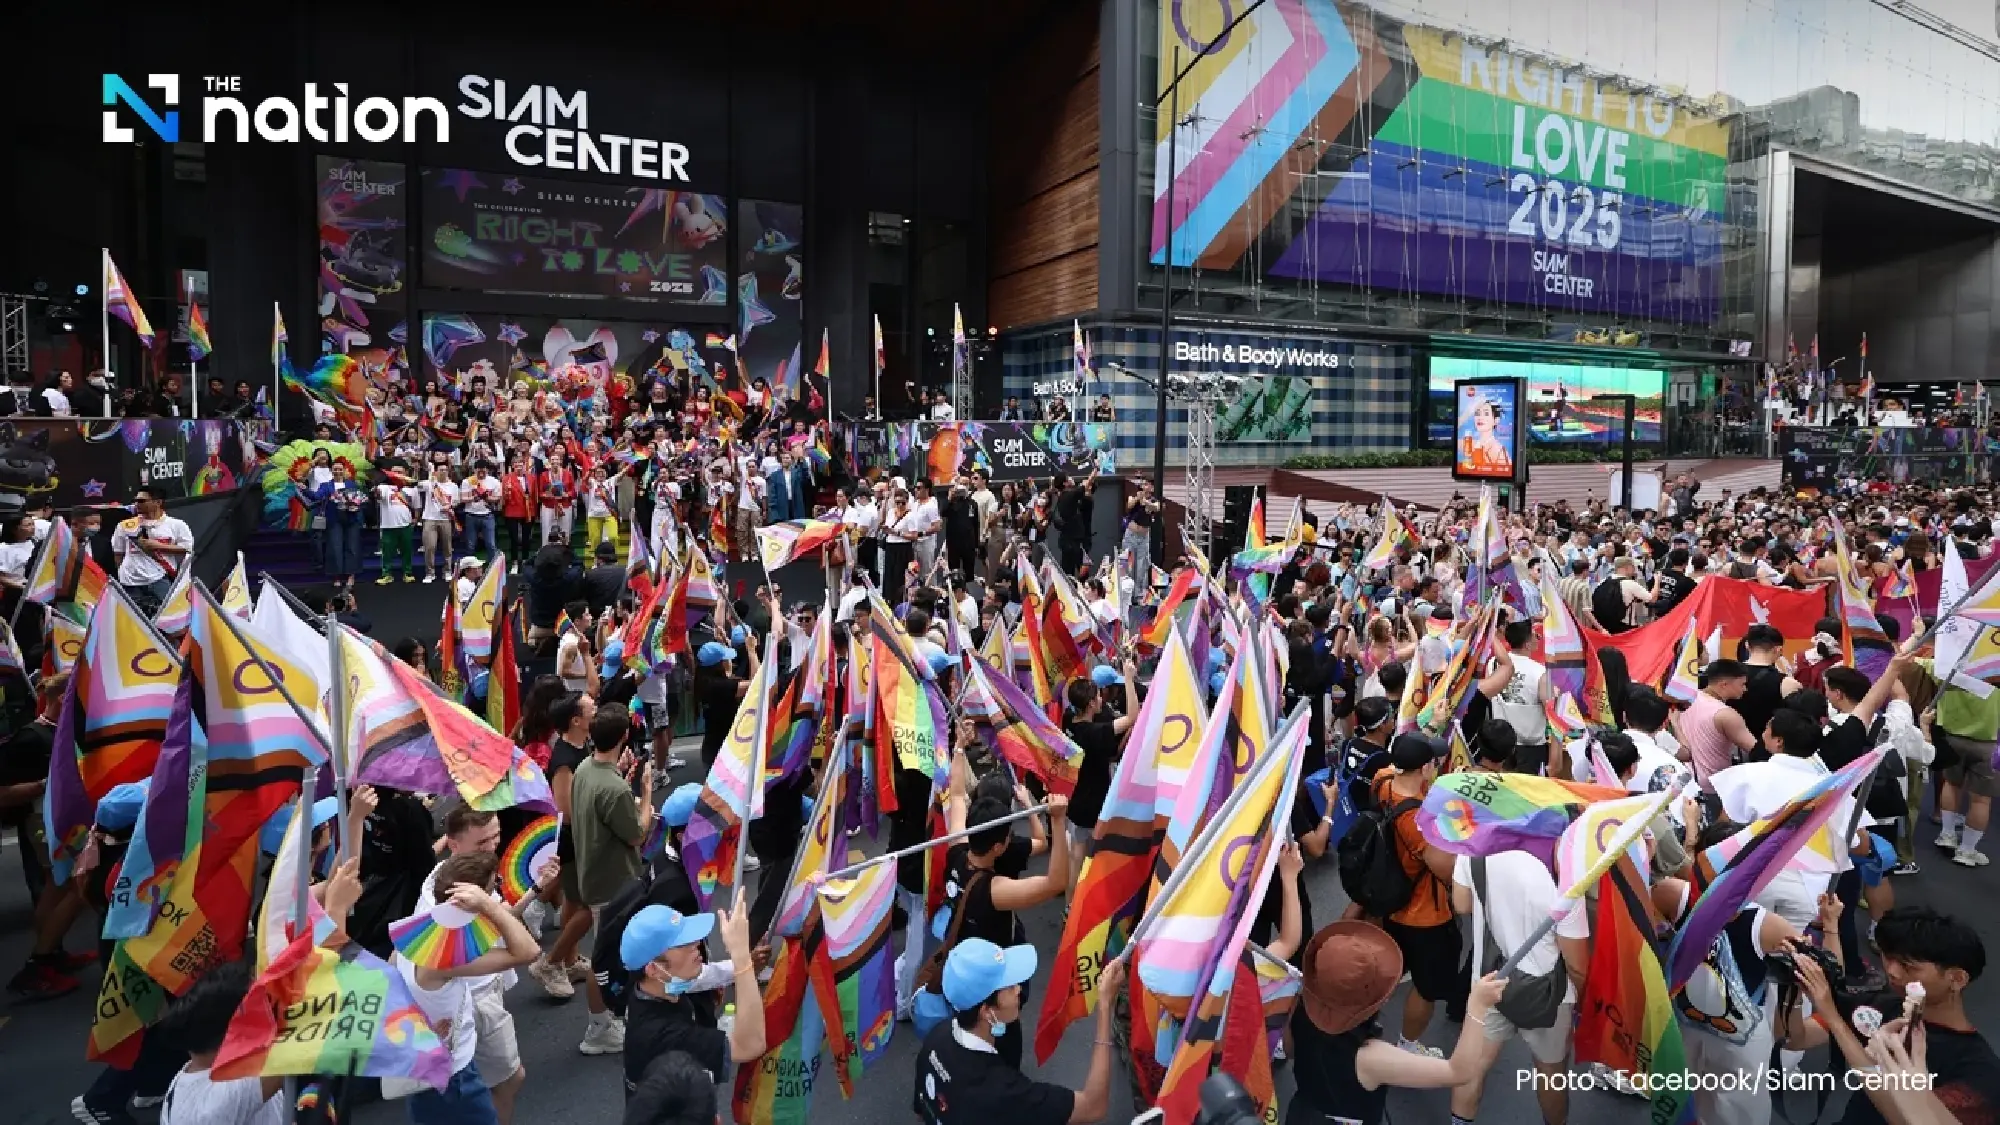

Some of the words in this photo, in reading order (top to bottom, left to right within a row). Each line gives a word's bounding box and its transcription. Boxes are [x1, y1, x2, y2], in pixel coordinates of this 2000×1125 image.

[457, 74, 588, 130] SIAM
[504, 124, 691, 182] CENTER
[1511, 104, 1631, 190] LOVE
[328, 167, 367, 183] SIAM
[342, 181, 396, 196] CENTER
[537, 191, 575, 203] SIAM
[584, 196, 637, 208] CENTER
[1508, 173, 1623, 250] 2025
[475, 213, 603, 248] RIGHT
[541, 248, 584, 272] TO
[593, 248, 693, 280] LOVE
[1533, 250, 1569, 275] SIAM
[1543, 273, 1594, 298] CENTER
[1174, 341, 1219, 363] Bath
[1223, 344, 1236, 364] &
[1239, 343, 1284, 369] Body
[1284, 347, 1339, 368] Works
[144, 447, 167, 464] SIAM
[993, 438, 1023, 454] SIAM
[152, 461, 184, 480] CENTER
[1004, 451, 1046, 467] CENTER
